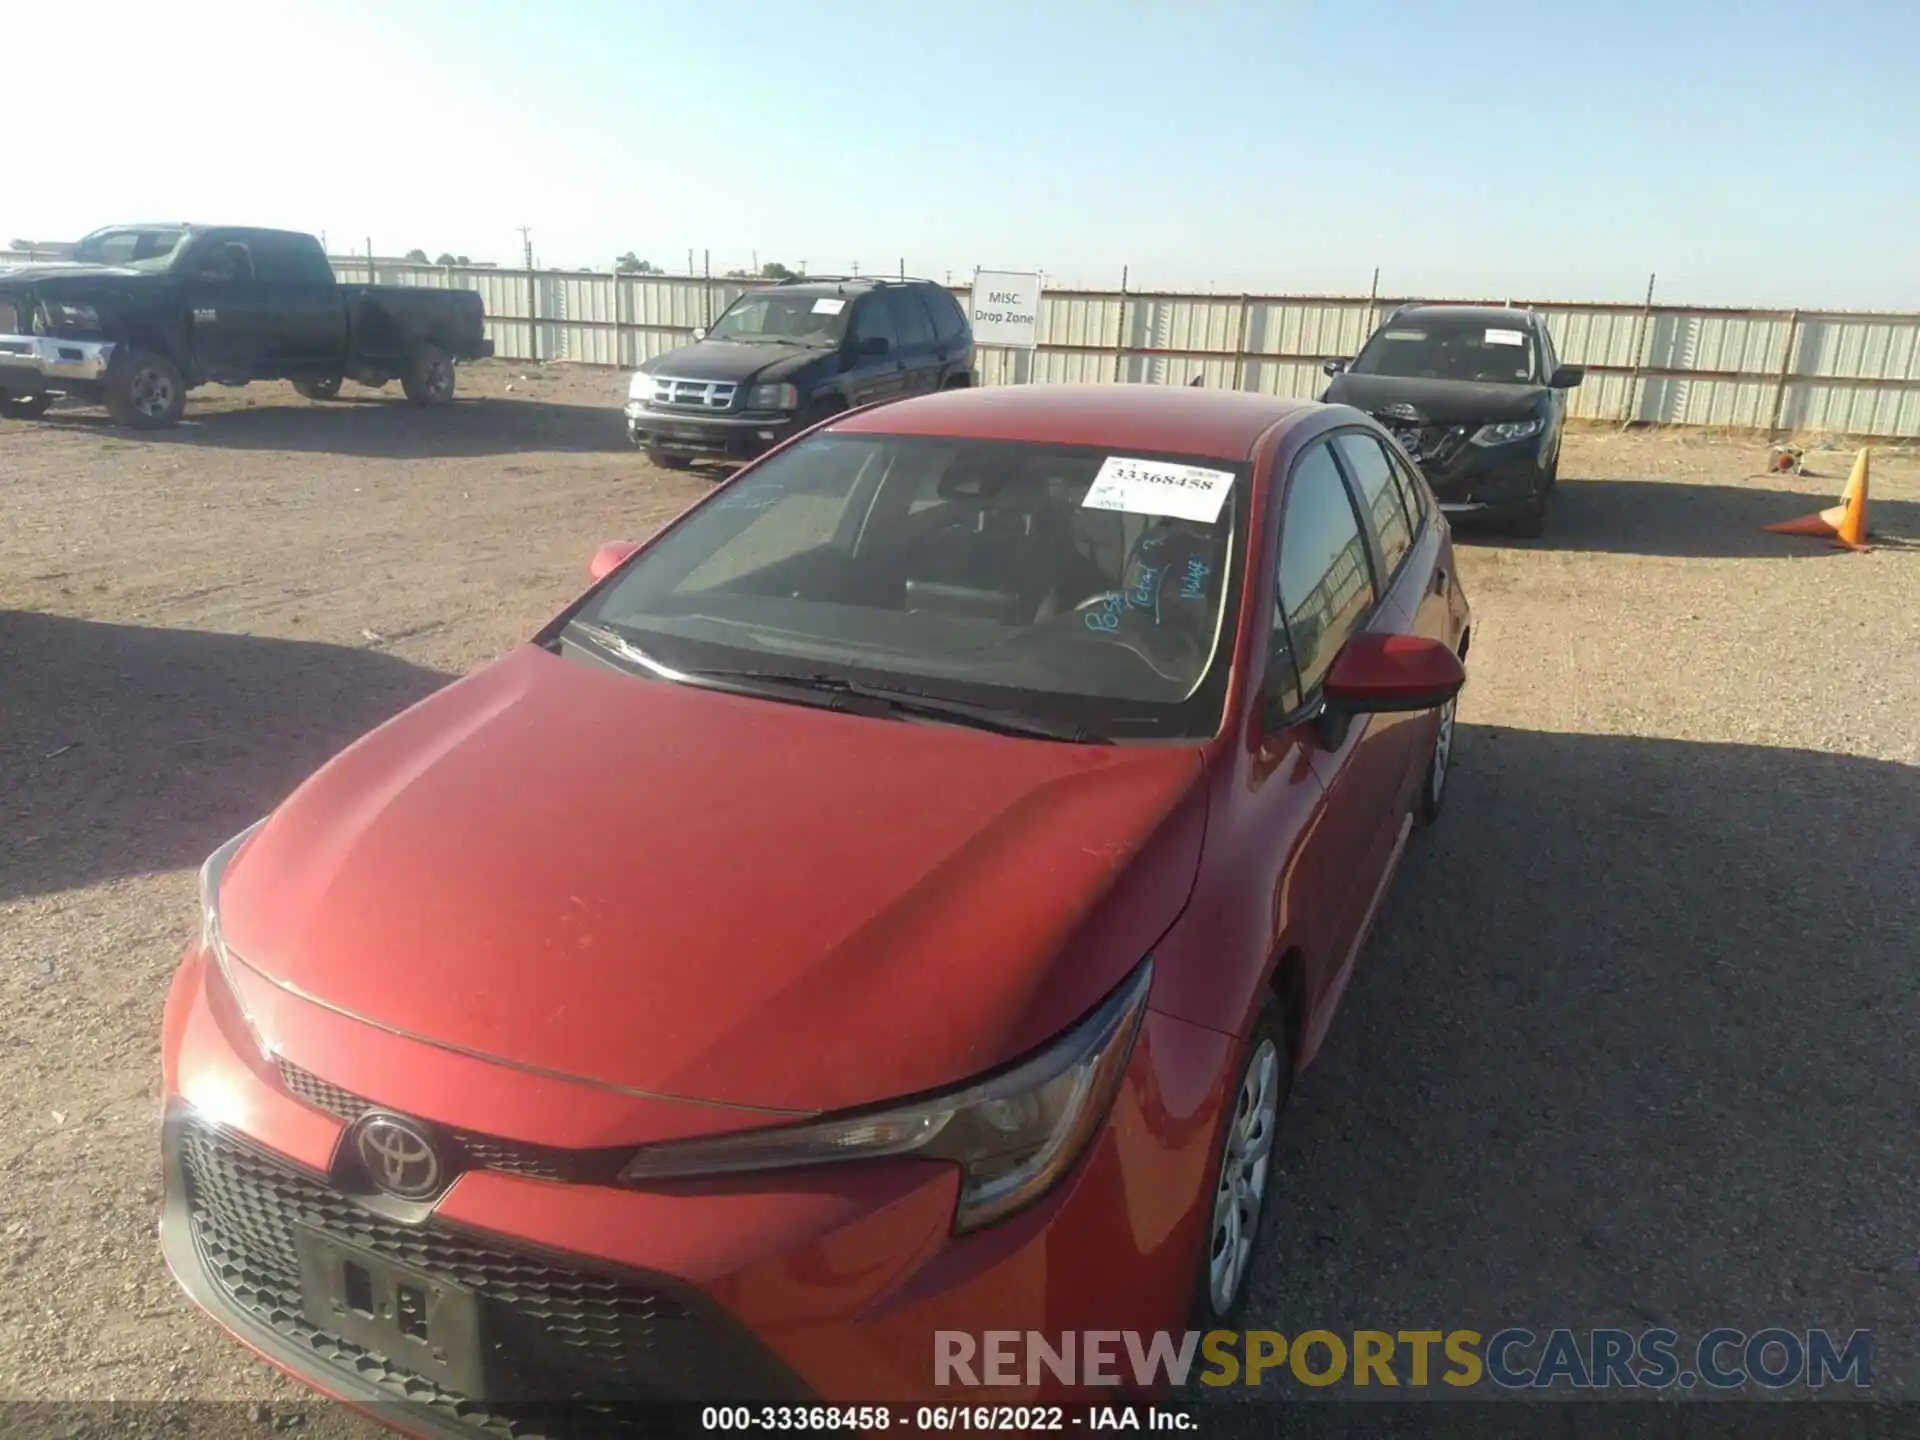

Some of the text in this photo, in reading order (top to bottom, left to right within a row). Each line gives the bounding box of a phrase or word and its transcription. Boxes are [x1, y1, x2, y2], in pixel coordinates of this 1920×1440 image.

[975, 310, 1034, 324] Drop Zone
[1116, 468, 1214, 491] 33368458
